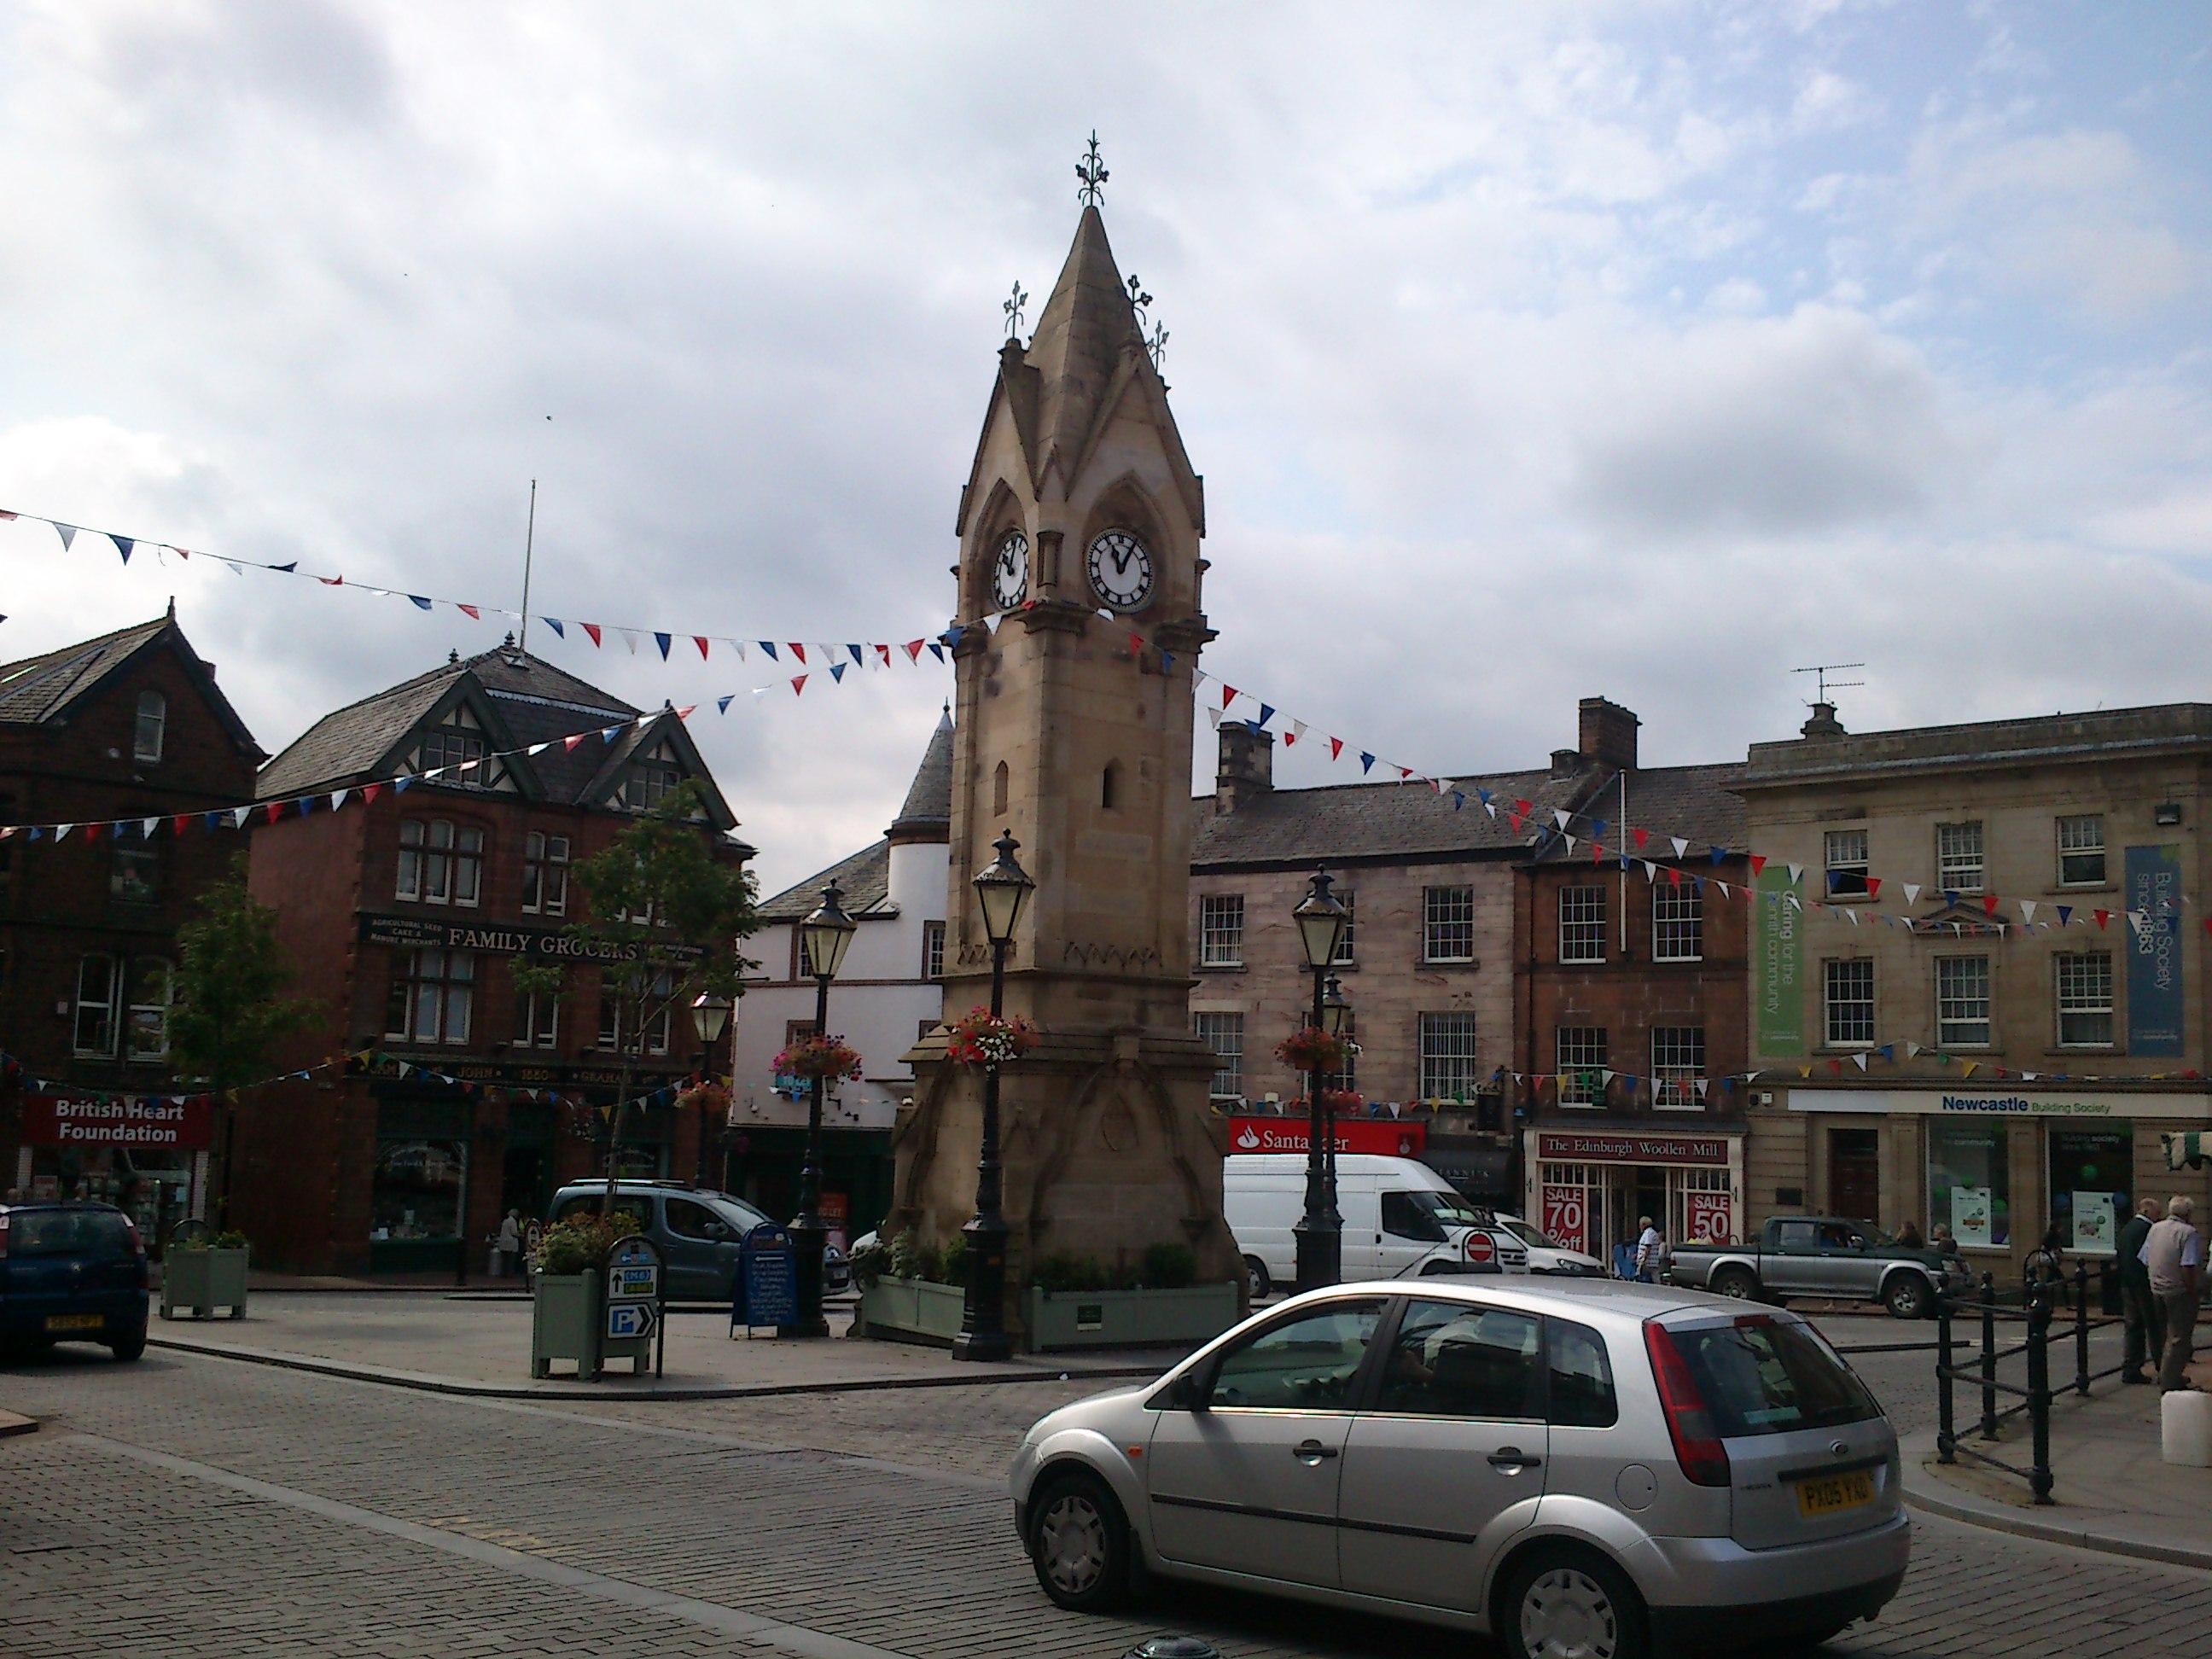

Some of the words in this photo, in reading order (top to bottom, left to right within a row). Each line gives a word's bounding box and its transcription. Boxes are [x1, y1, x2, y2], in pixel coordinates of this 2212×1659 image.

[2154, 872, 2173, 933] Building
[1780, 890, 1797, 940] Caring
[448, 928, 532, 952] FAMILY
[540, 935, 638, 960] GROCERS
[1782, 942, 1796, 961] for
[1782, 963, 1796, 985] the
[2154, 936, 2174, 991] Society
[1764, 940, 1780, 1015] community
[55, 1099, 124, 1119] British
[128, 1102, 184, 1121] Heart
[1942, 1097, 2029, 1111] Newcastle
[2032, 1102, 2071, 1114] Building
[2074, 1103, 2111, 1115] Society
[59, 1121, 177, 1143] Foundation
[1263, 1130, 1349, 1151] Santaer
[1547, 1138, 1569, 1151] The
[1575, 1140, 1633, 1157] Edinburgh
[1639, 1141, 1686, 1155] Woollen
[1692, 1143, 1719, 1156] Mill
[1545, 1187, 1582, 1202] SALE
[1694, 1195, 1729, 1210] SALE
[1546, 1202, 1581, 1230] 70
[1693, 1211, 1729, 1239] 50
[626, 1270, 650, 1281] (M6)
[617, 1312, 633, 1331] P
